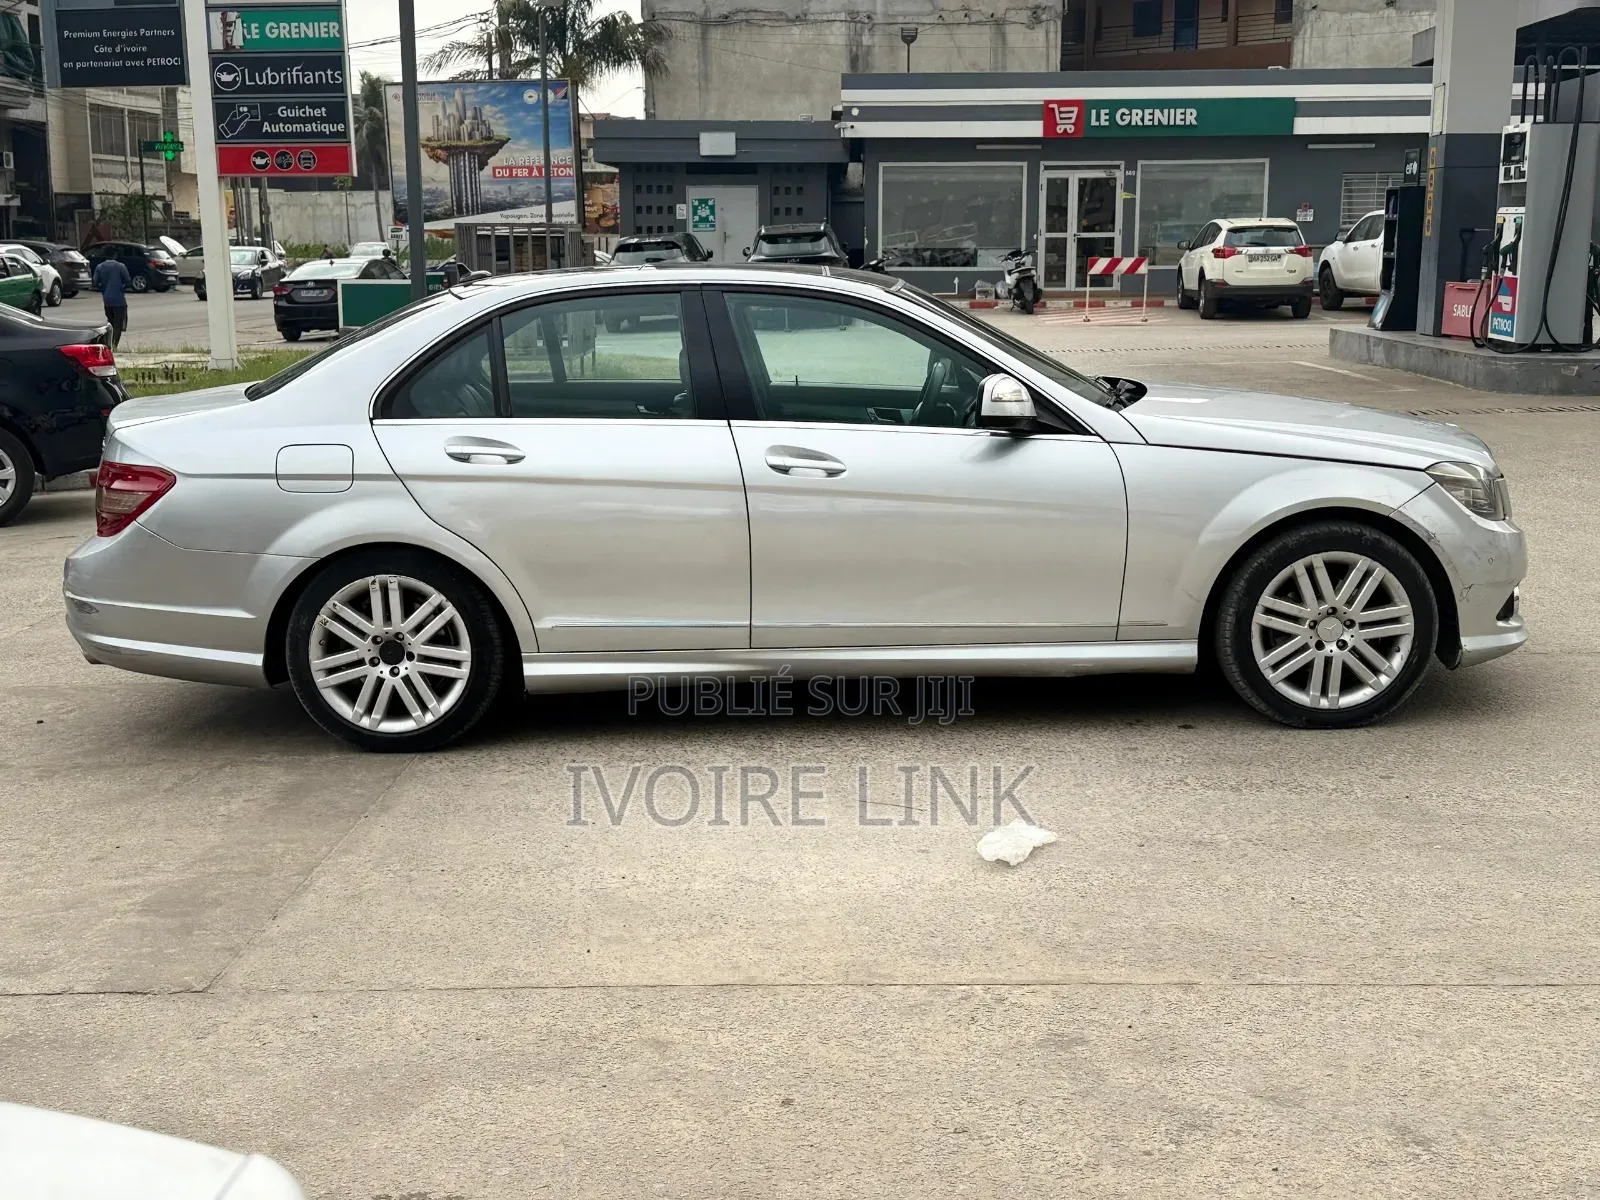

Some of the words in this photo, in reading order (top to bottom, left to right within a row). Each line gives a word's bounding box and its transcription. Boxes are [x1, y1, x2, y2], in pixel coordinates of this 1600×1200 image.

[63, 30, 101, 39] Premium
[102, 29, 138, 39] Energies
[139, 28, 176, 37] Partners
[243, 23, 260, 39] LE
[265, 22, 341, 38] GRENIER
[94, 44, 113, 53] Côte
[115, 44, 148, 53] d'ivoire
[76, 59, 123, 70] partenariat
[146, 57, 181, 66] PETROCI
[244, 66, 343, 86] Lubrifiants
[277, 105, 327, 118] Guichet
[1090, 109, 1110, 126] LE
[1115, 107, 1198, 126] GRENIER
[262, 120, 345, 135] Automatique
[503, 156, 516, 166] LA
[518, 155, 572, 166] RÉFÉRNCE
[495, 168, 509, 177] DU
[512, 168, 529, 177] FER
[532, 166, 540, 177] À
[545, 211, 575, 219] ustrielle
